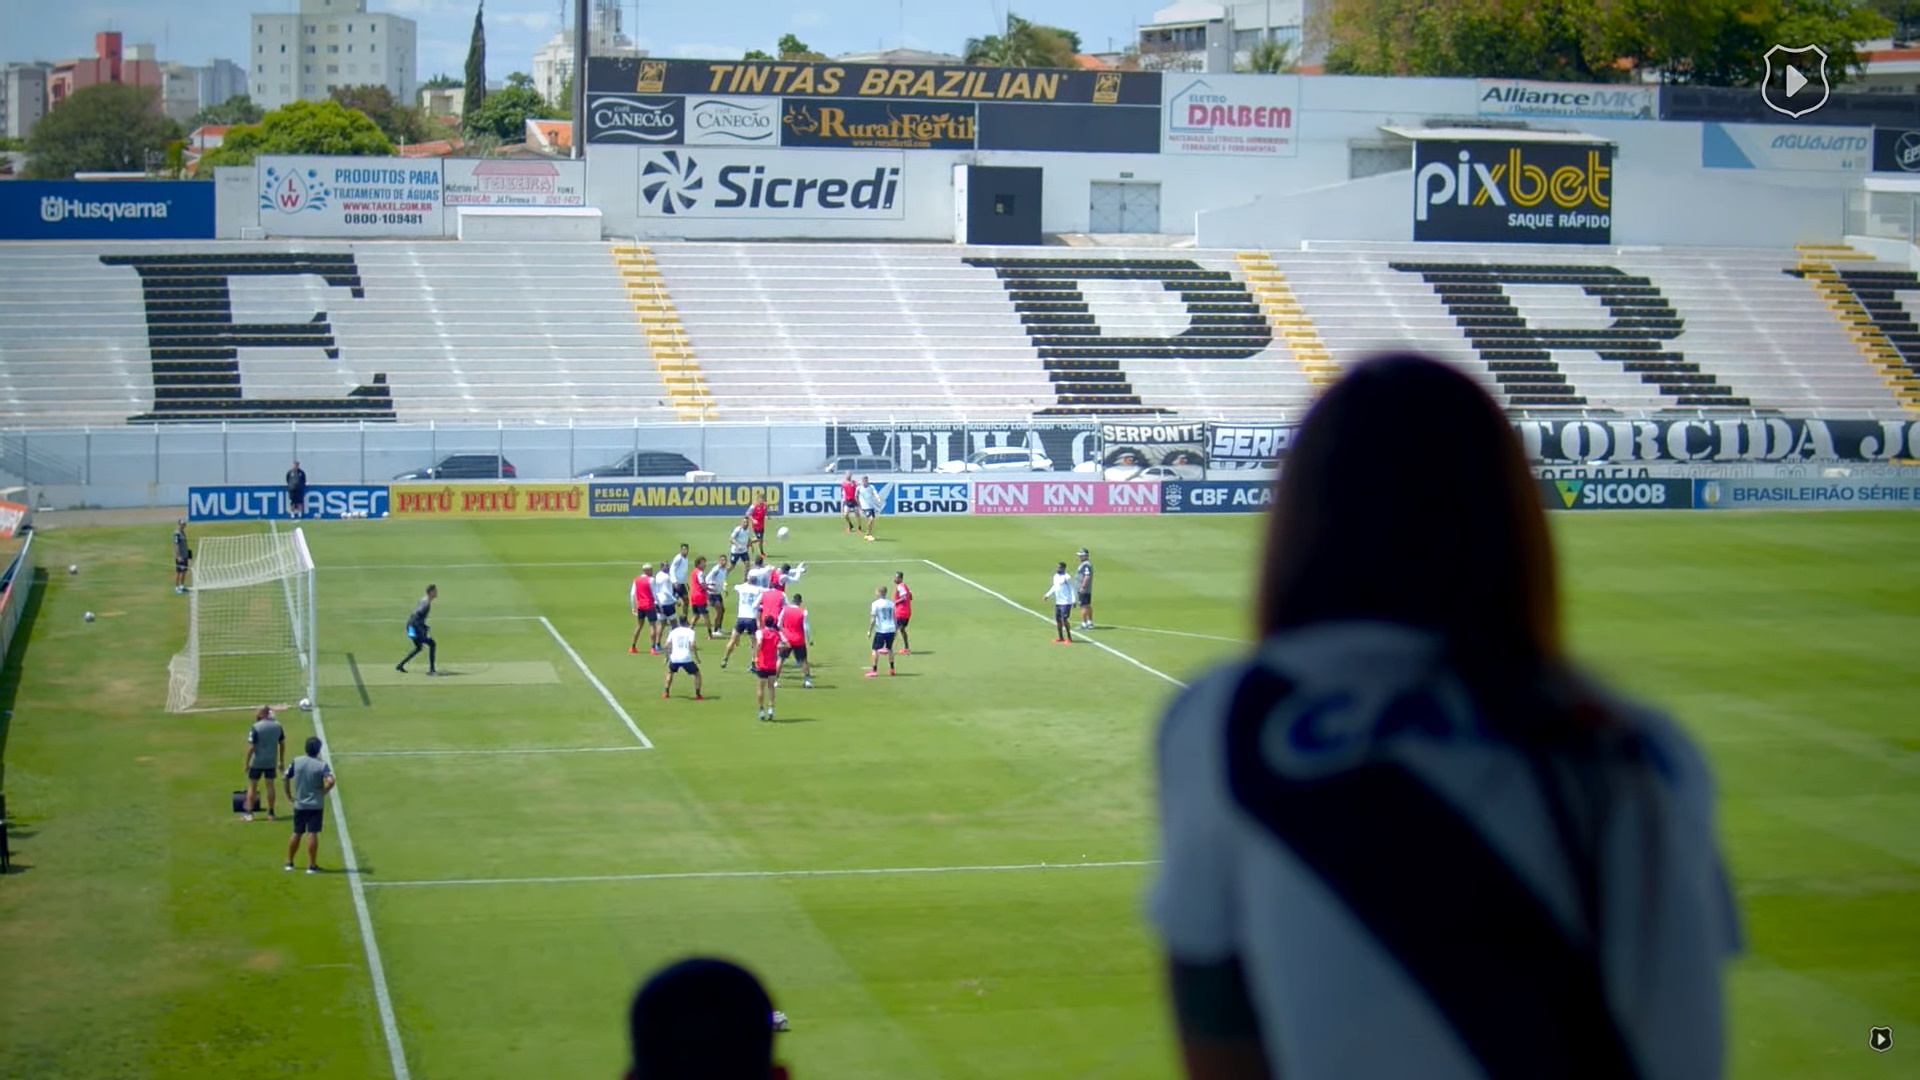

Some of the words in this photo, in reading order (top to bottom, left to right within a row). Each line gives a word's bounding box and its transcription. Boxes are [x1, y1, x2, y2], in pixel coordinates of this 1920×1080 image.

[708, 64, 846, 95] TINTAS
[858, 68, 1061, 99] BRAZILIAN
[594, 109, 674, 129] CANECÃO
[1188, 104, 1292, 129] DALBEM
[1771, 134, 1868, 151] AGUAJATO
[335, 168, 406, 185] PRODUTOS
[409, 170, 439, 185] PARA
[1415, 148, 1610, 221] pixbet
[333, 187, 391, 200] TRATAMENTO
[393, 188, 405, 200] DE
[407, 187, 439, 201] ÁGUAS
[714, 165, 901, 210] Sicredi
[64, 199, 168, 222] Husqvarna
[342, 202, 433, 212] WWW.TAKEL.COM.BR
[1508, 213, 1554, 230] SAQUE
[1558, 211, 1611, 229] RÁPIDO
[1104, 424, 1203, 443] SERPONTE
[1212, 428, 1292, 458] SERP
[1511, 420, 1839, 460] TORCIDA
[1860, 420, 1920, 459] J
[594, 488, 630, 498] PESCA
[631, 486, 781, 507] AMAZONLORD
[793, 486, 842, 500] TE
[978, 484, 1029, 506] KNN
[1044, 484, 1094, 506] KNN
[1109, 484, 1159, 506] KNN
[1190, 488, 1229, 506] CBF
[1231, 488, 1277, 505] ACA
[1583, 483, 1666, 505] SICOOB
[1733, 484, 1854, 501] BRASILEIRÃO
[1858, 484, 1910, 500] SÉRIE
[594, 502, 630, 513] ECOTUR
[789, 501, 842, 514] BON
[898, 501, 968, 514] BOND
